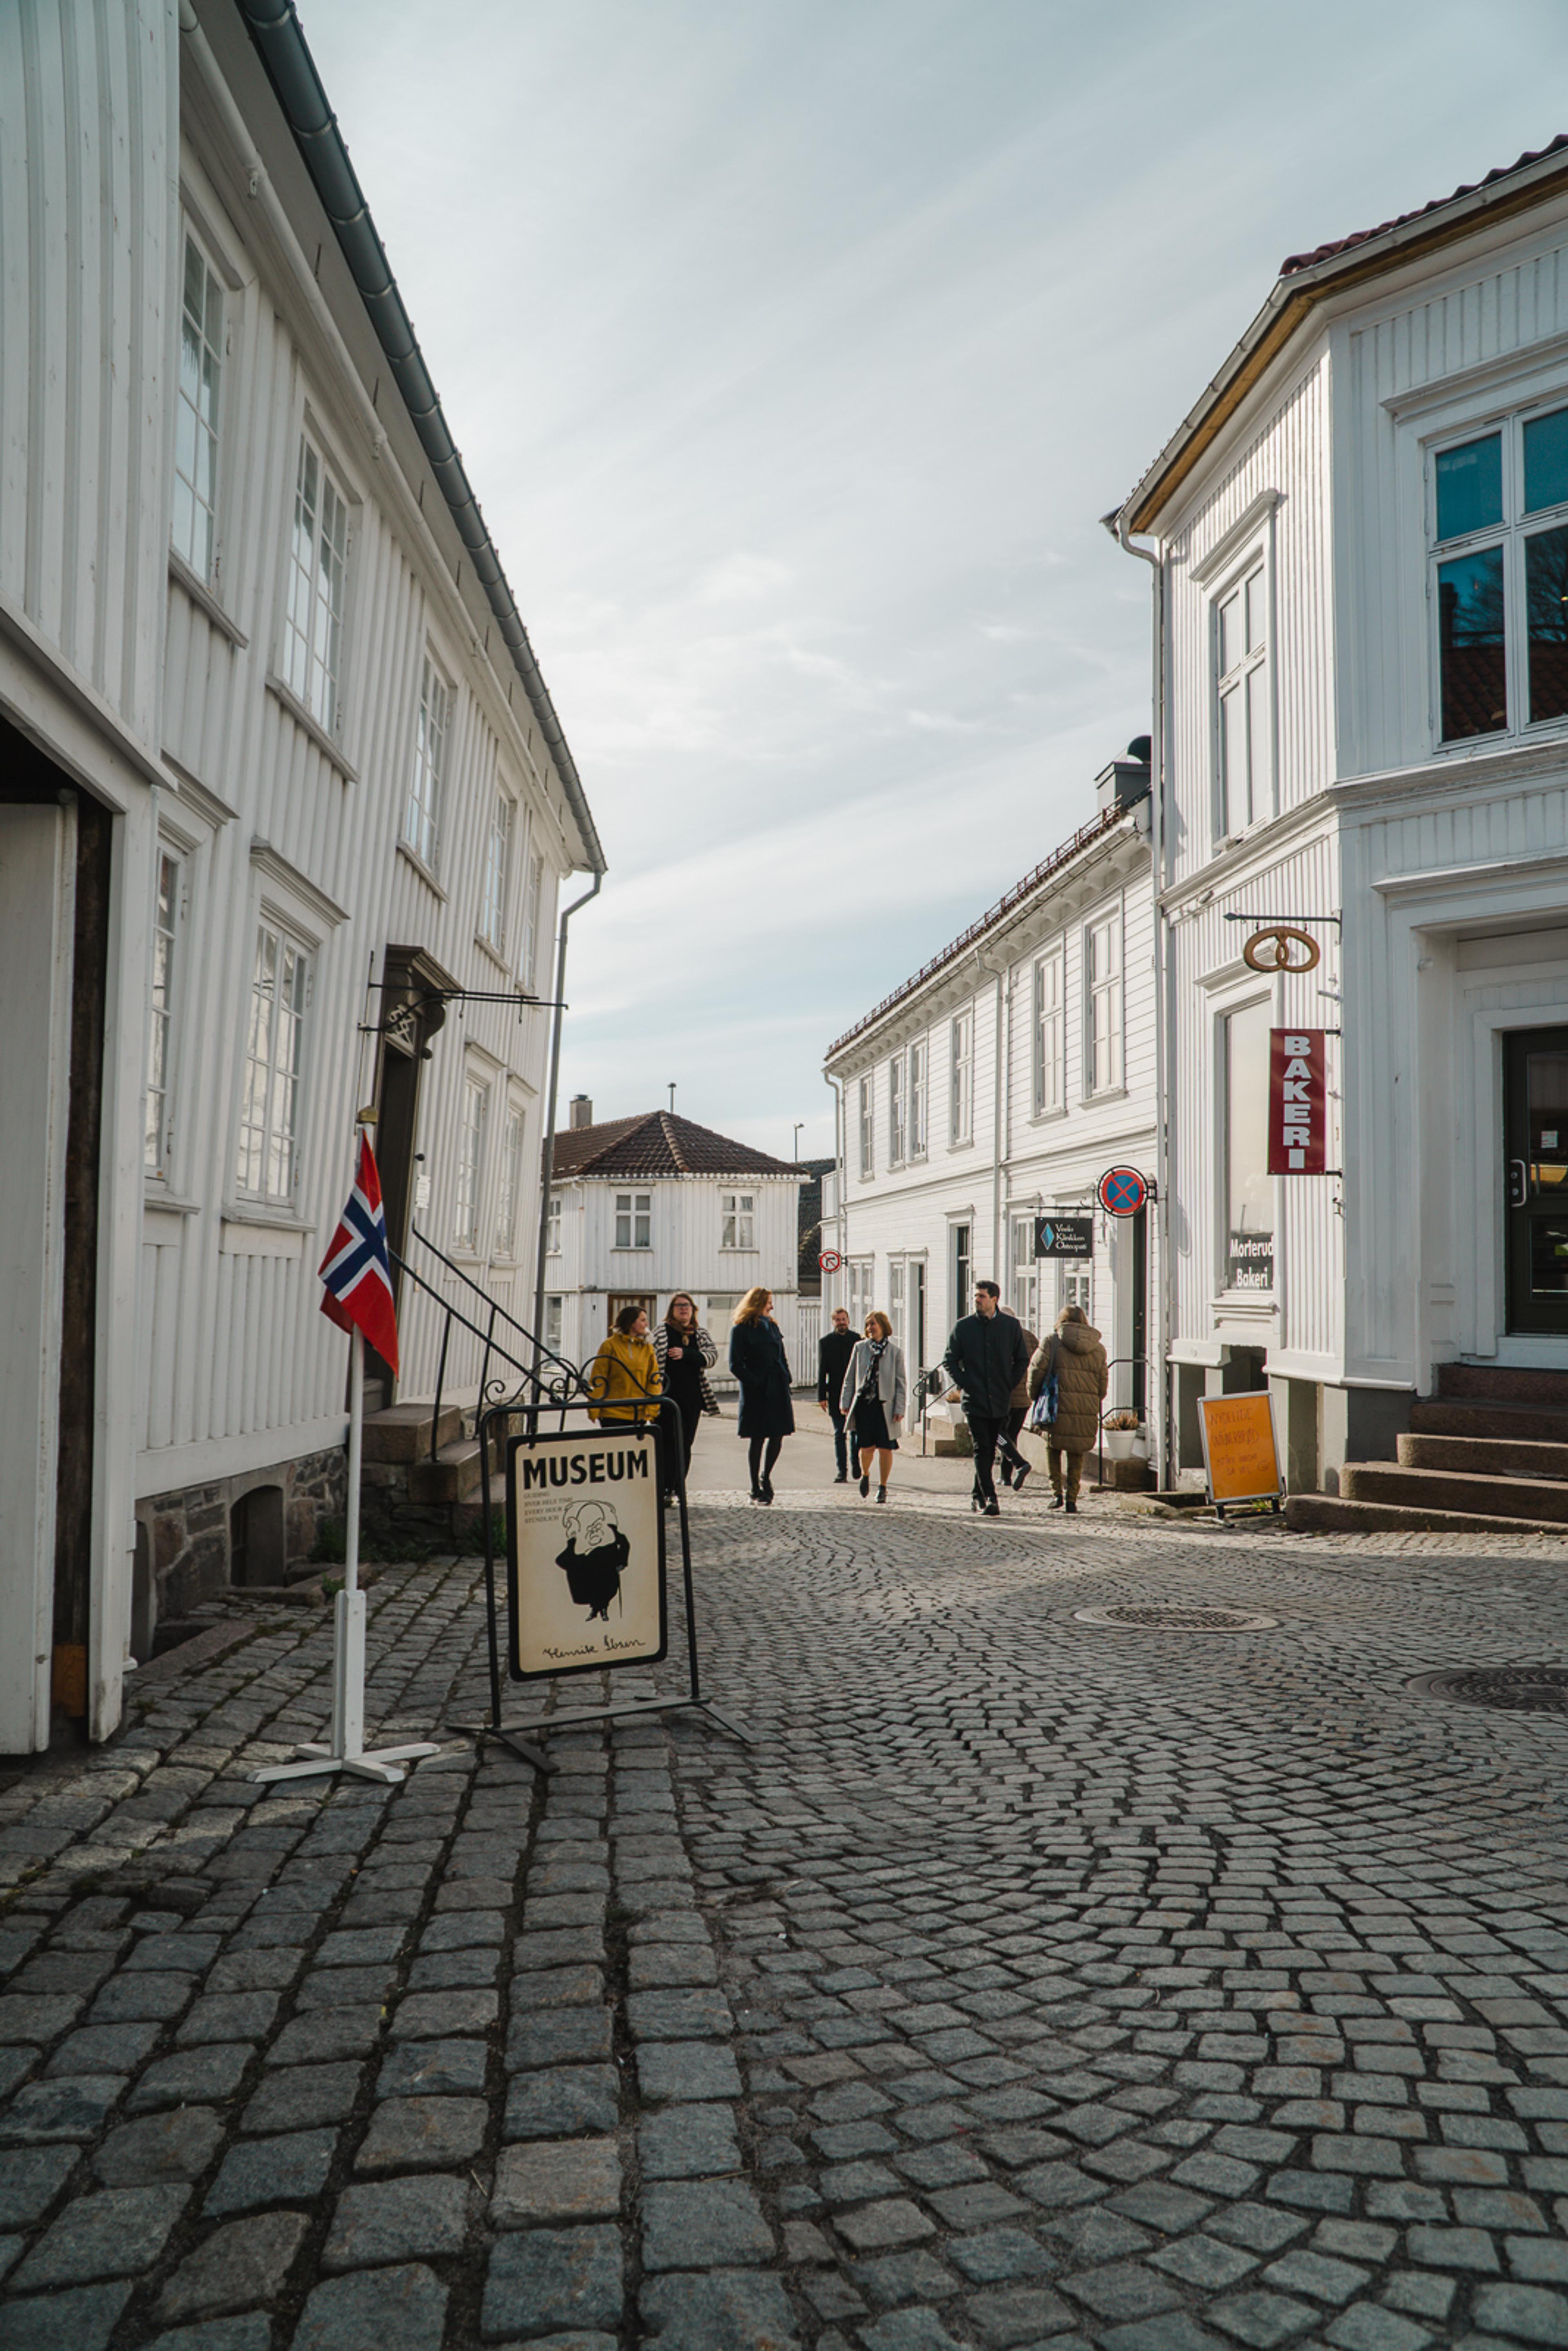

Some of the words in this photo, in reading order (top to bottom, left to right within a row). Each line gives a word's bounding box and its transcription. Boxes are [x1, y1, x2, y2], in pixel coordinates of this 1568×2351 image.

[1283, 1036, 1311, 1169] BAKERI
[1236, 1267, 1267, 1287] Bakeri
[523, 1449, 648, 1490] MUSEUM
